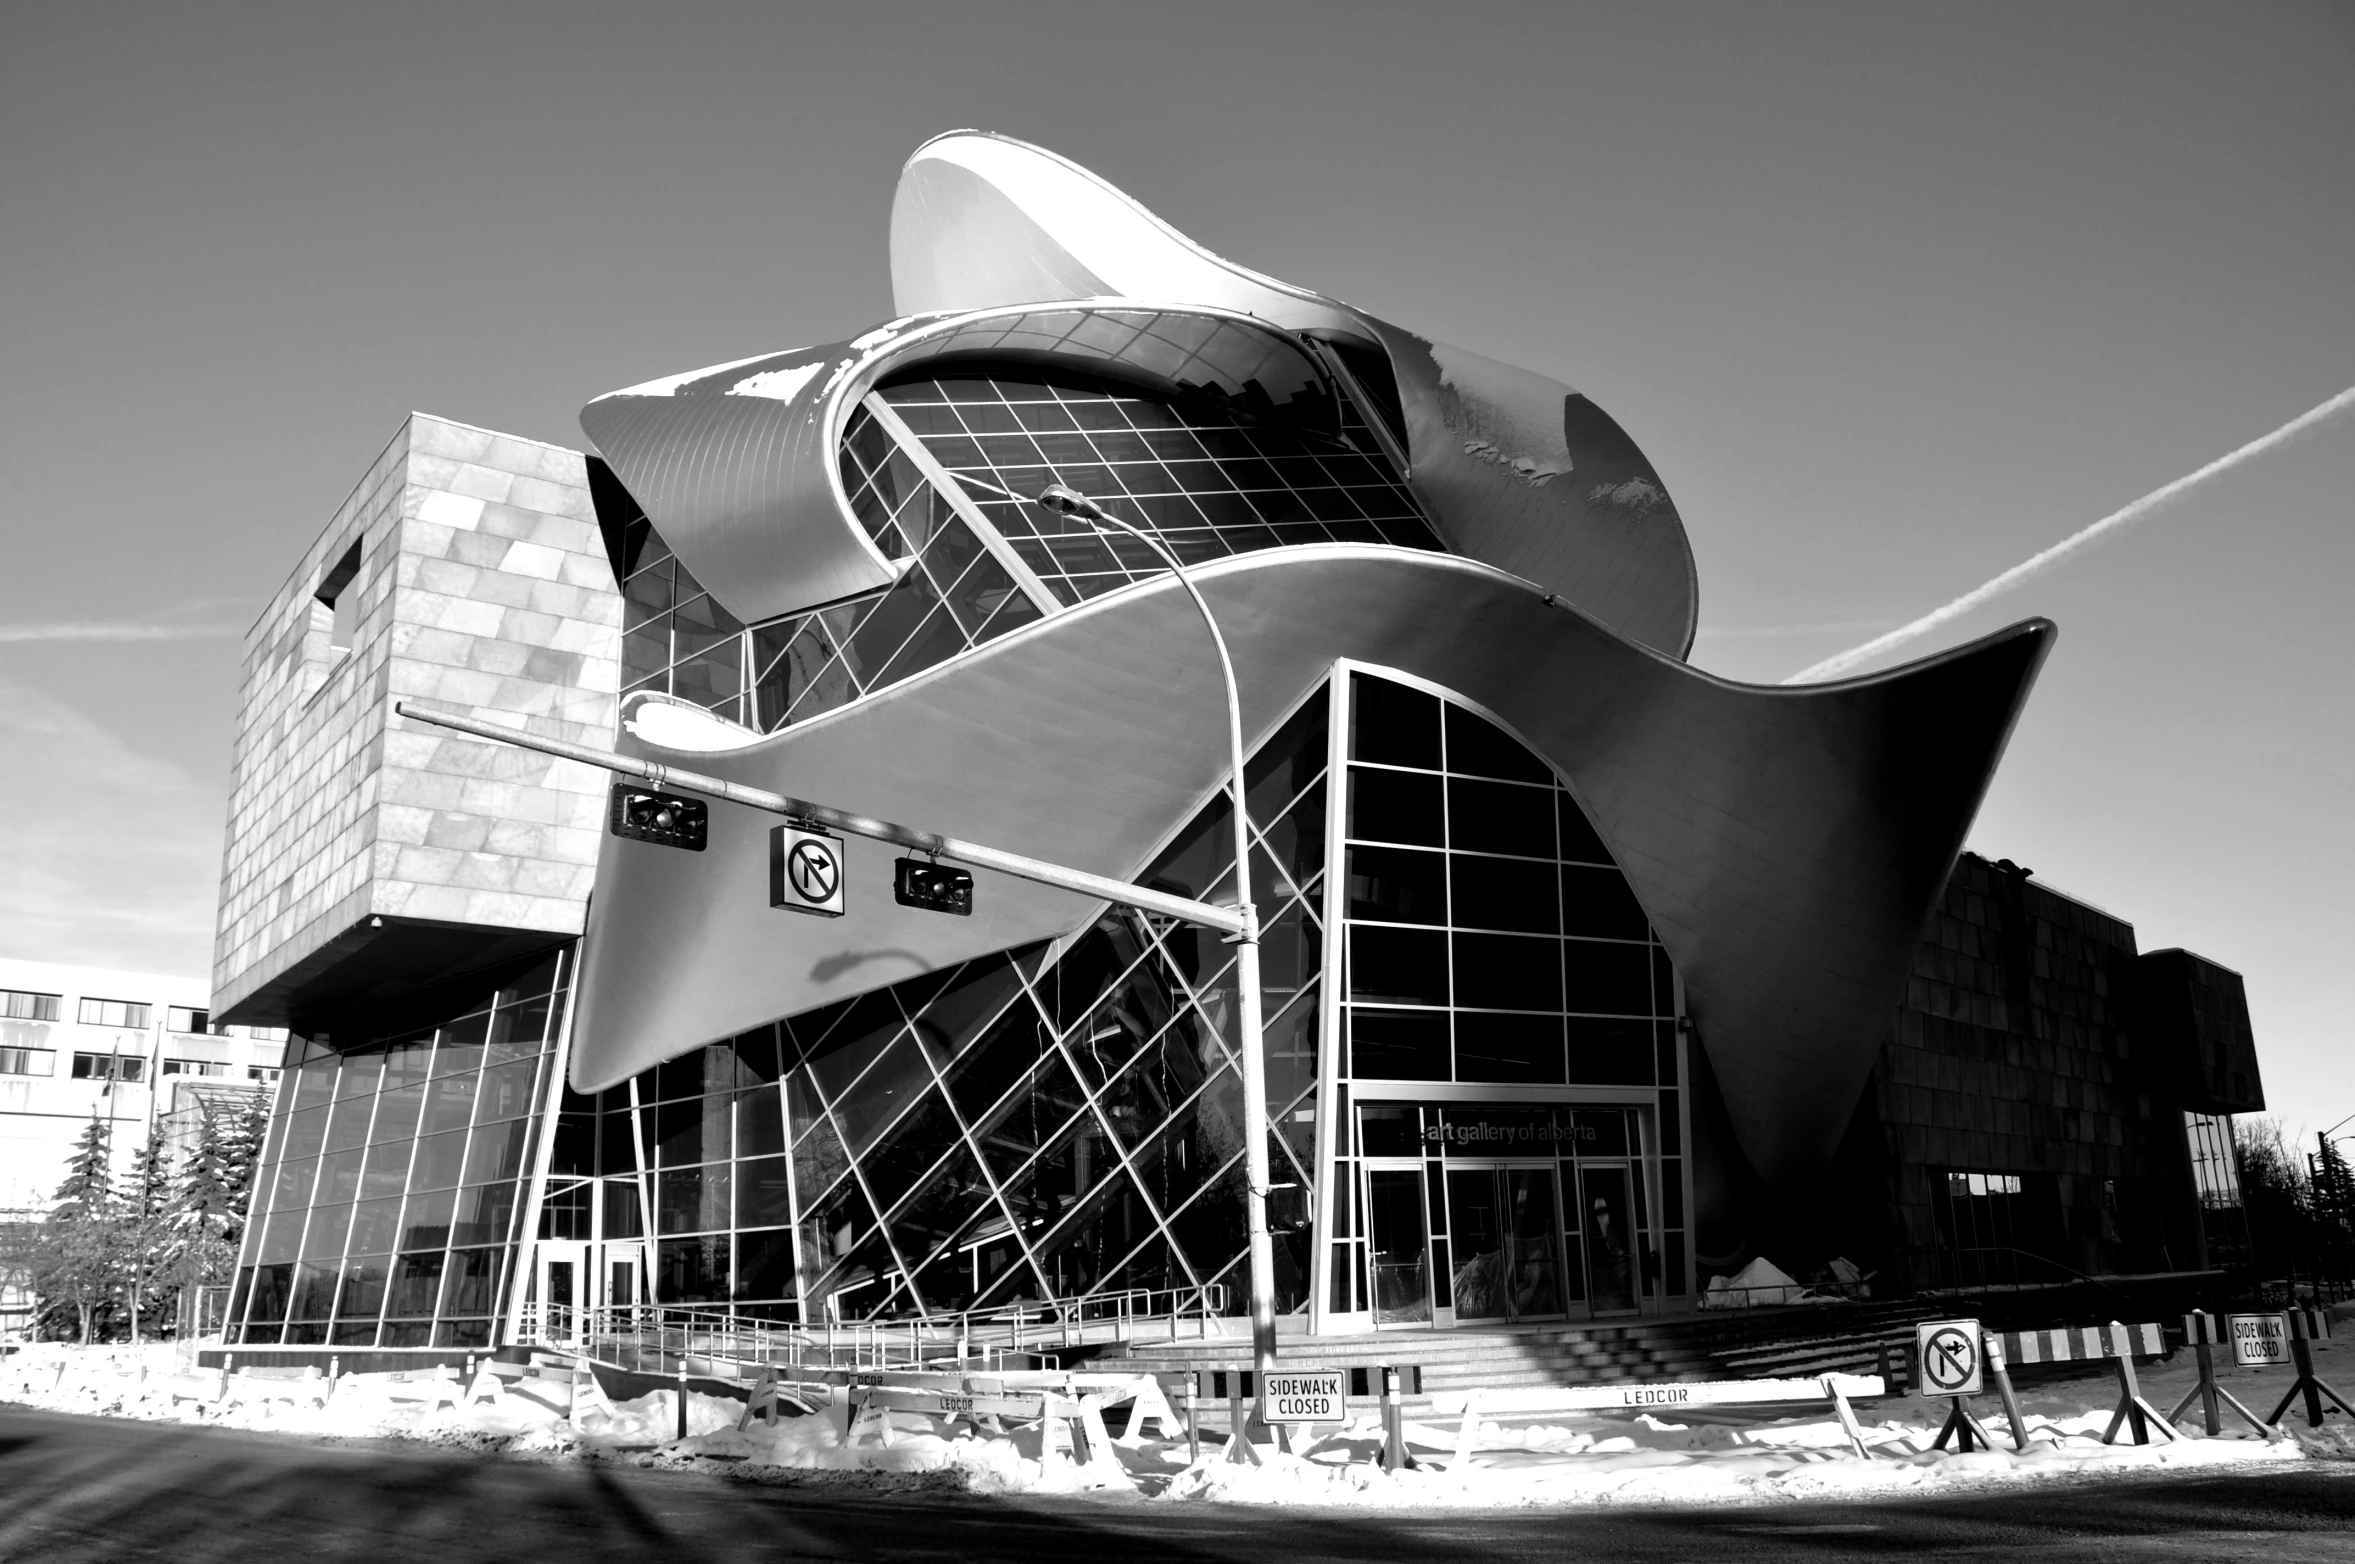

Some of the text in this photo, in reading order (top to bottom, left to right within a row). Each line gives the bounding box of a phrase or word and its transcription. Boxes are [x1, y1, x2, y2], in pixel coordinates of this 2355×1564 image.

[1427, 1122, 1597, 1145] art gallery of alberta
[2236, 1322, 2282, 1339] SIDEWALK
[2244, 1341, 2279, 1358] CLOSED
[1269, 1379, 1338, 1396] SIDEWALK
[1624, 1388, 1688, 1404] LEDCOR
[940, 1397, 973, 1411] LEDCOR
[1279, 1398, 1330, 1415] CLOSED
